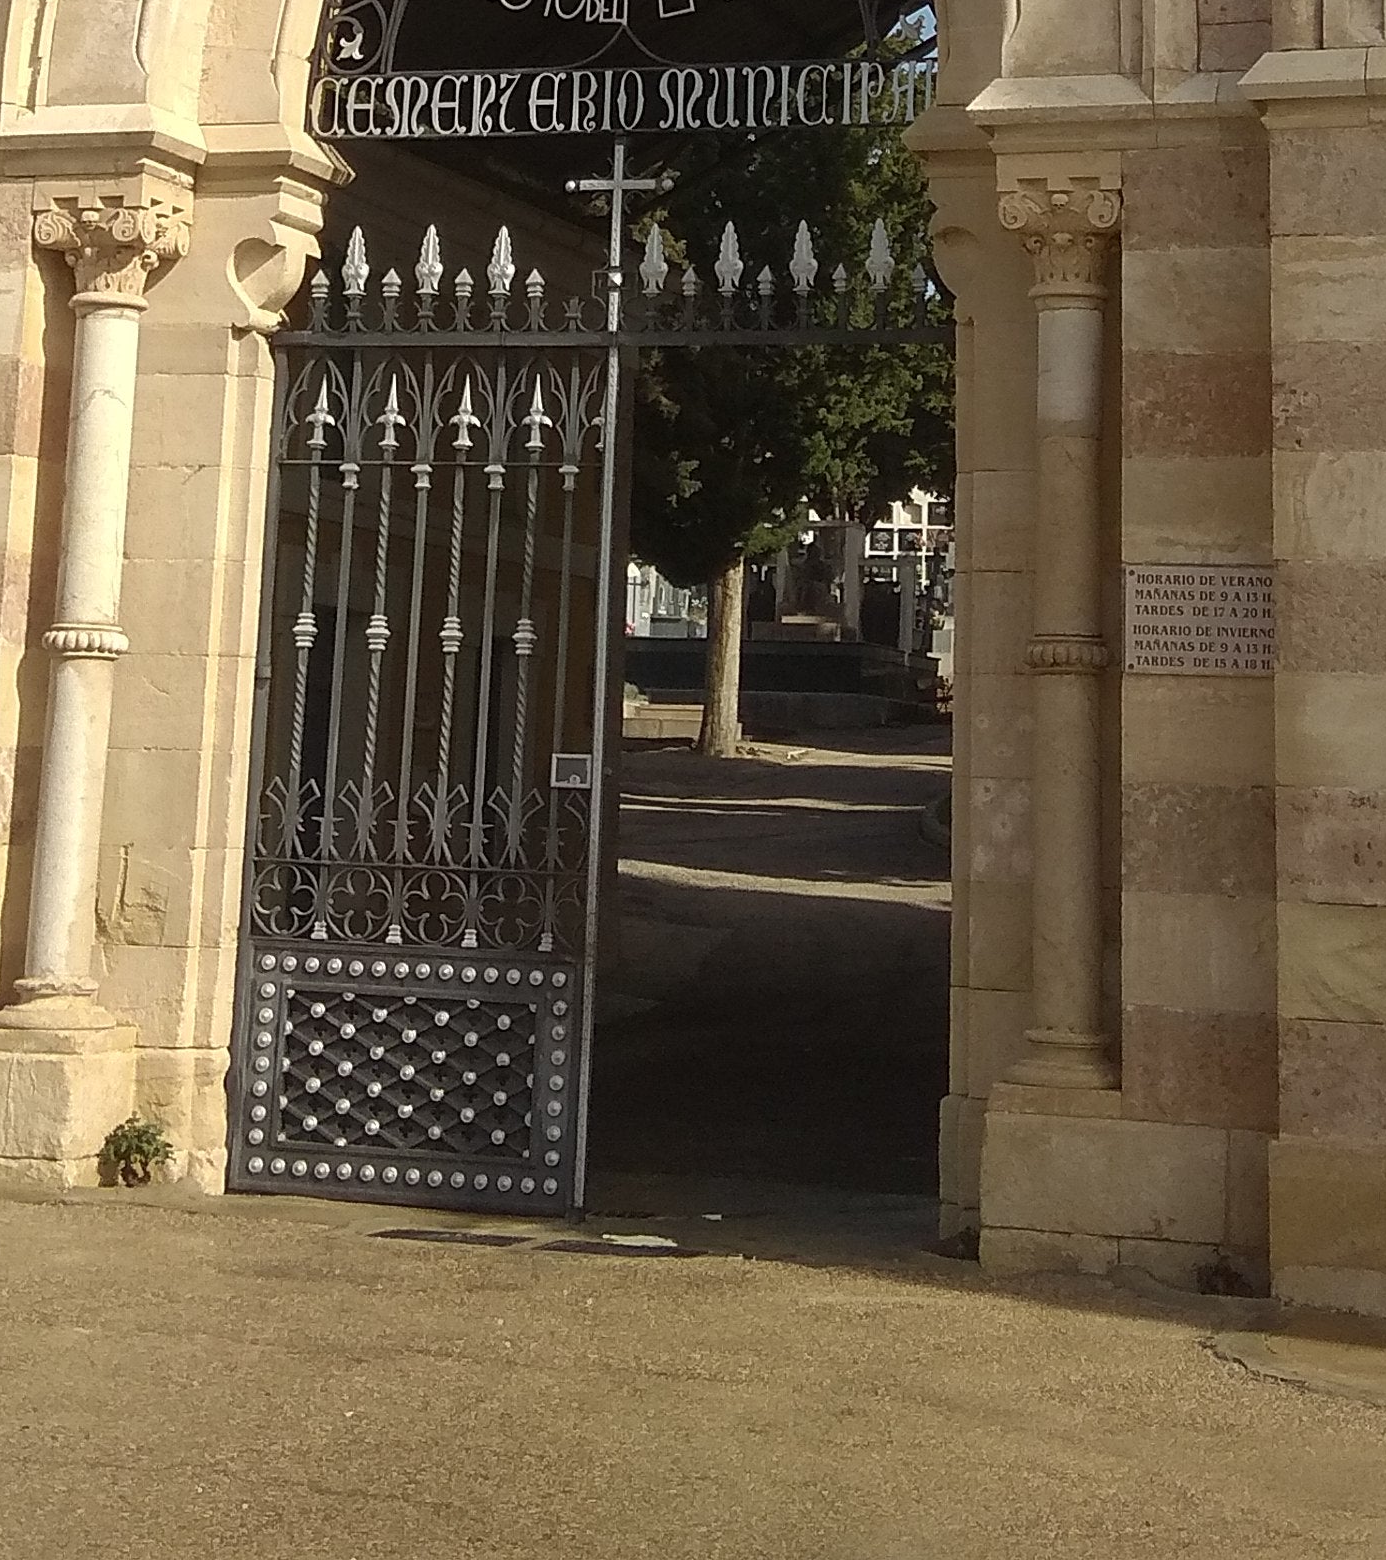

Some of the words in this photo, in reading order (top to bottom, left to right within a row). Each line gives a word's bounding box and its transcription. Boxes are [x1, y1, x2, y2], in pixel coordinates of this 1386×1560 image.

[1136, 573, 1195, 586] HORARIO
[1199, 575, 1215, 586] DE
[1221, 576, 1273, 588] VERANO
[1134, 588, 1195, 601] MAÑANAS
[1199, 590, 1215, 601] DE
[1220, 591, 1228, 602] 9
[1232, 591, 1241, 602] A
[1246, 592, 1258, 603] 13
[1135, 604, 1184, 616] TARDES
[1192, 606, 1209, 617] DE
[1214, 607, 1225, 617] 17
[1230, 607, 1238, 618] A
[1242, 608, 1257, 618] 20
[1133, 624, 1191, 637] HORARIO
[1196, 626, 1212, 637] DE
[1134, 638, 1194, 652] MAÑANAS
[1199, 641, 1215, 652] DE
[1220, 642, 1228, 653] 9
[1232, 642, 1241, 653] A
[1246, 643, 1258, 654] 13
[1135, 655, 1185, 667] TARDES
[1193, 657, 1210, 668] DE
[1214, 657, 1226, 668] 15
[1230, 658, 1239, 669] A
[1244, 658, 1258, 669] 18
